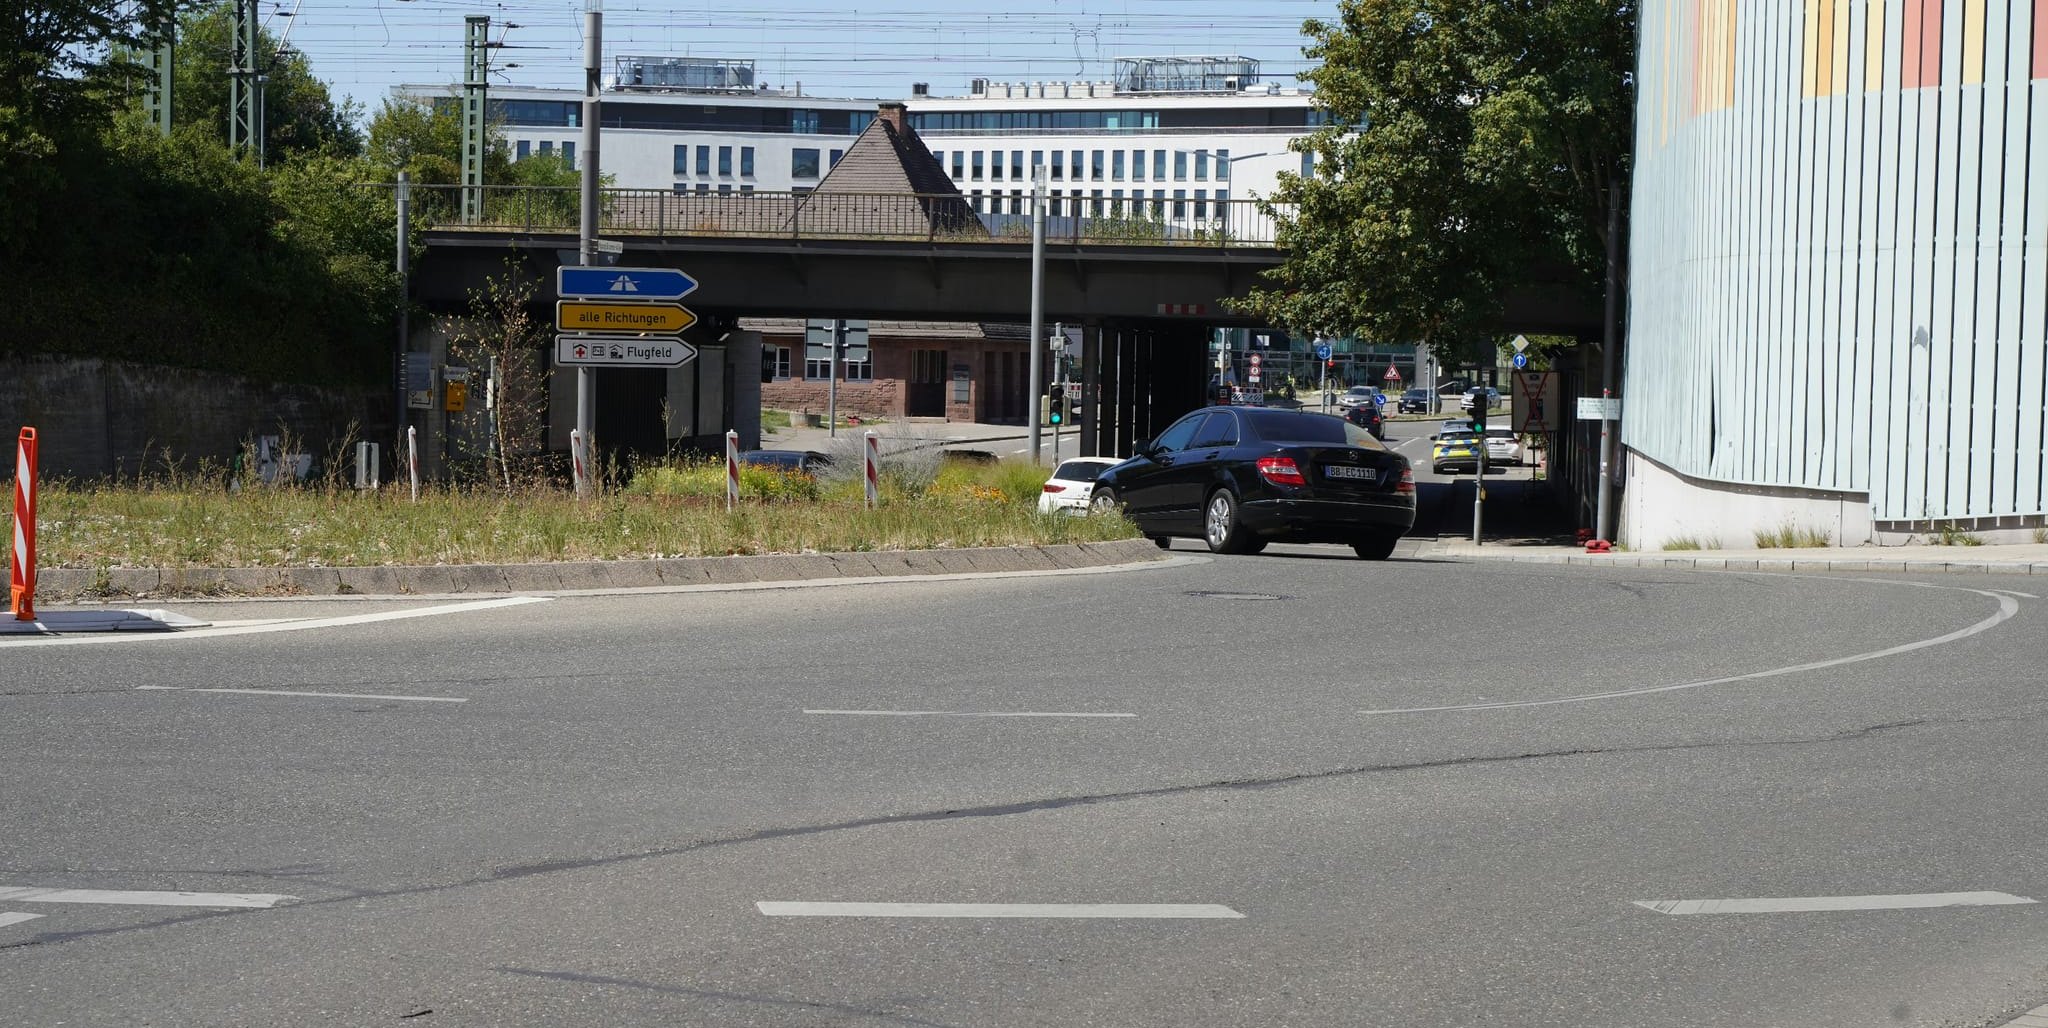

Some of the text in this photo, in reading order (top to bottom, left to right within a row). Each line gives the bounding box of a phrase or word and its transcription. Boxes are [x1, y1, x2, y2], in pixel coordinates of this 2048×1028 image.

[579, 311, 666, 326] alle Richtungen
[627, 346, 672, 360] Flugfeld
[1330, 466, 1341, 476] BB
